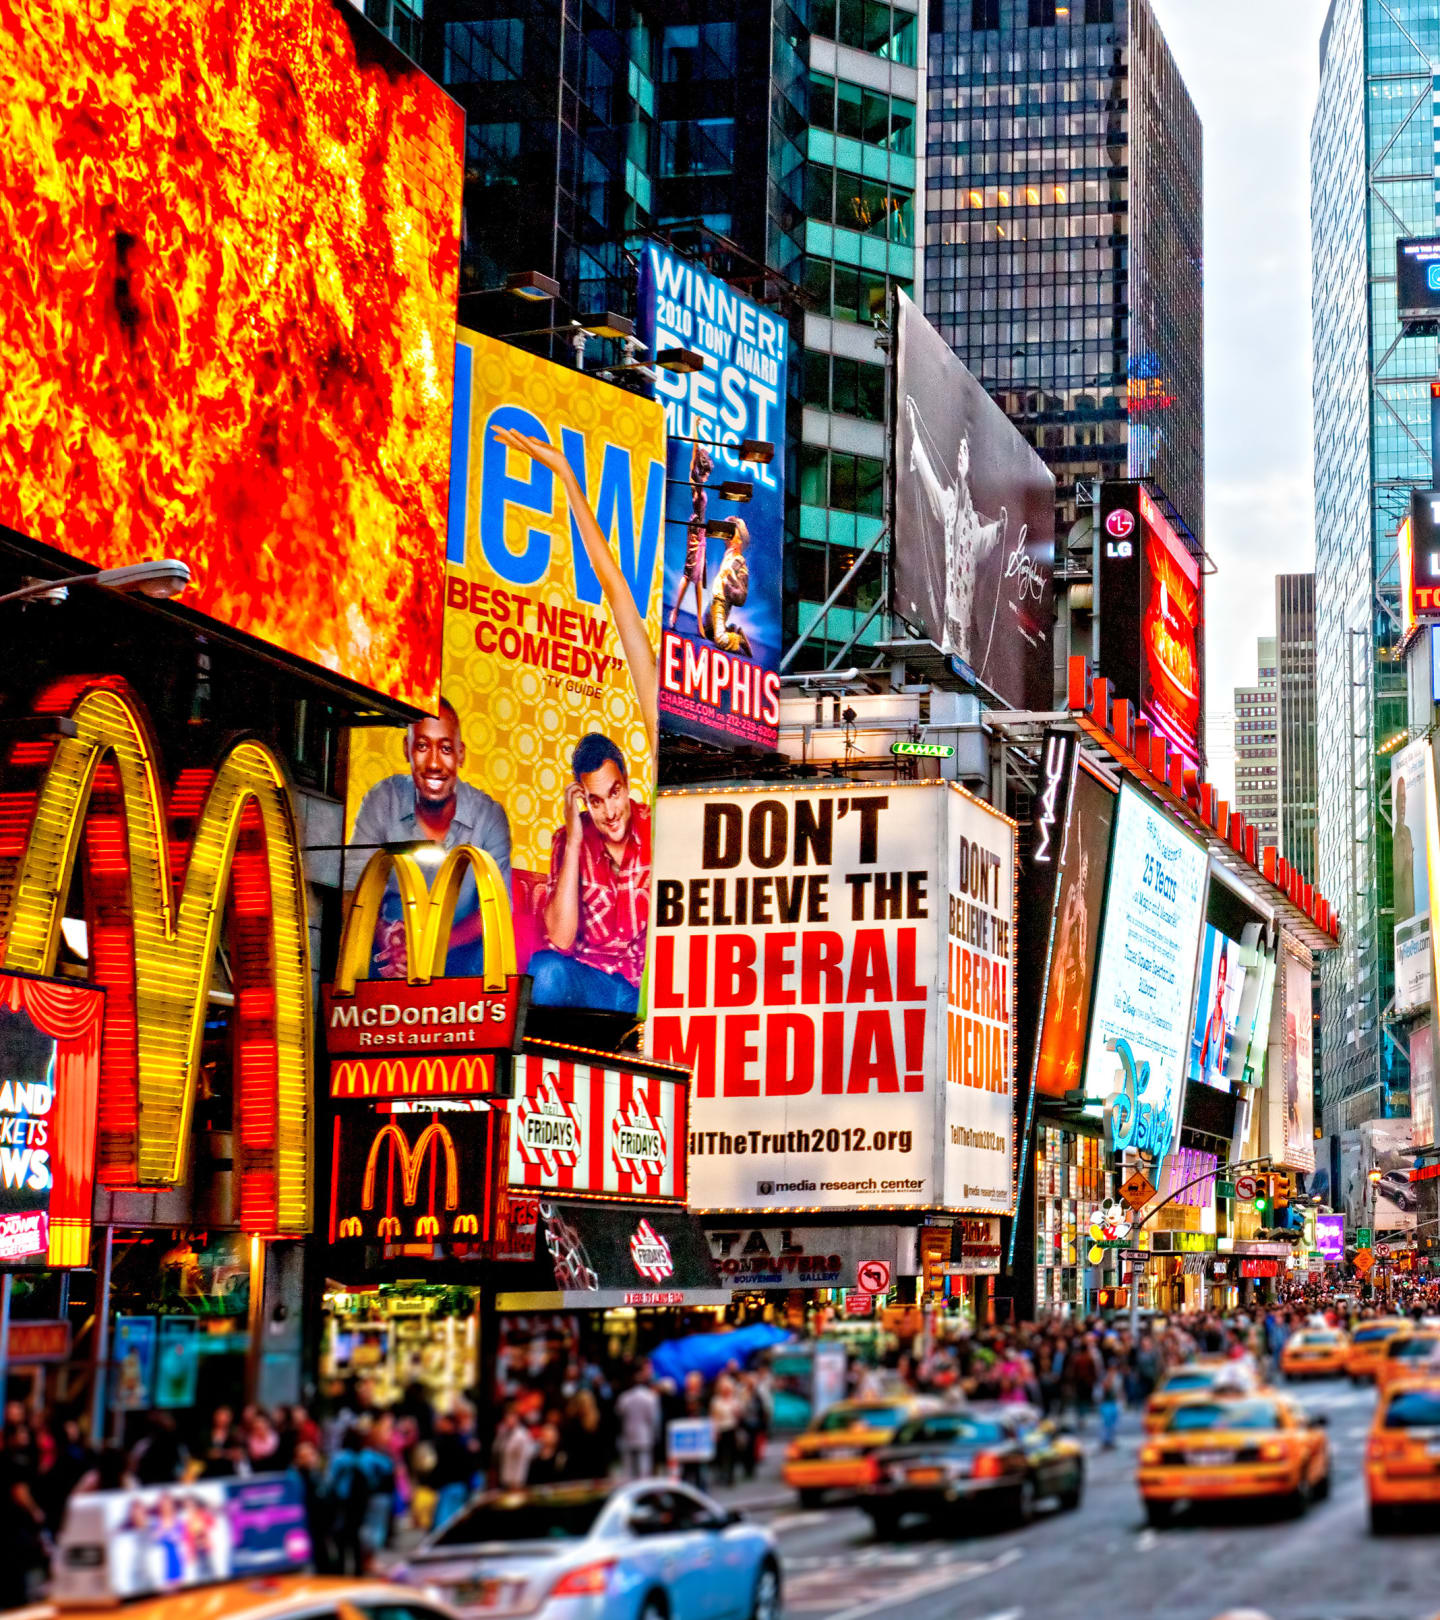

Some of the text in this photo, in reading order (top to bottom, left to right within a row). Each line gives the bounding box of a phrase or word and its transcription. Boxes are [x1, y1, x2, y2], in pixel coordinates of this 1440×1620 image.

[651, 248, 784, 360] WINNER!
[657, 295, 777, 386] 2010 TONY AWARD
[656, 327, 777, 443] BEST
[1107, 542, 1132, 558] LG
[446, 575, 607, 647] BEST NEW
[566, 678, 603, 700] GUIDE
[898, 743, 948, 755] LAMAR
[656, 871, 928, 927] BELIEVE THE
[1143, 853, 1177, 904] 25 Years
[949, 894, 1010, 959] BELIEVE THE
[654, 928, 928, 1009] LIBERAL
[948, 941, 1010, 1025] LIBERAL
[331, 1001, 506, 1028] McDonald's
[359, 1029, 475, 1047] Restaurant
[652, 1009, 926, 1099] MEDIA!
[948, 1011, 1009, 1096] MEDIA!
[0, 1080, 52, 1115] AND
[775, 1178, 923, 1192] media research center
[711, 1254, 842, 1275] COMPUTERS
